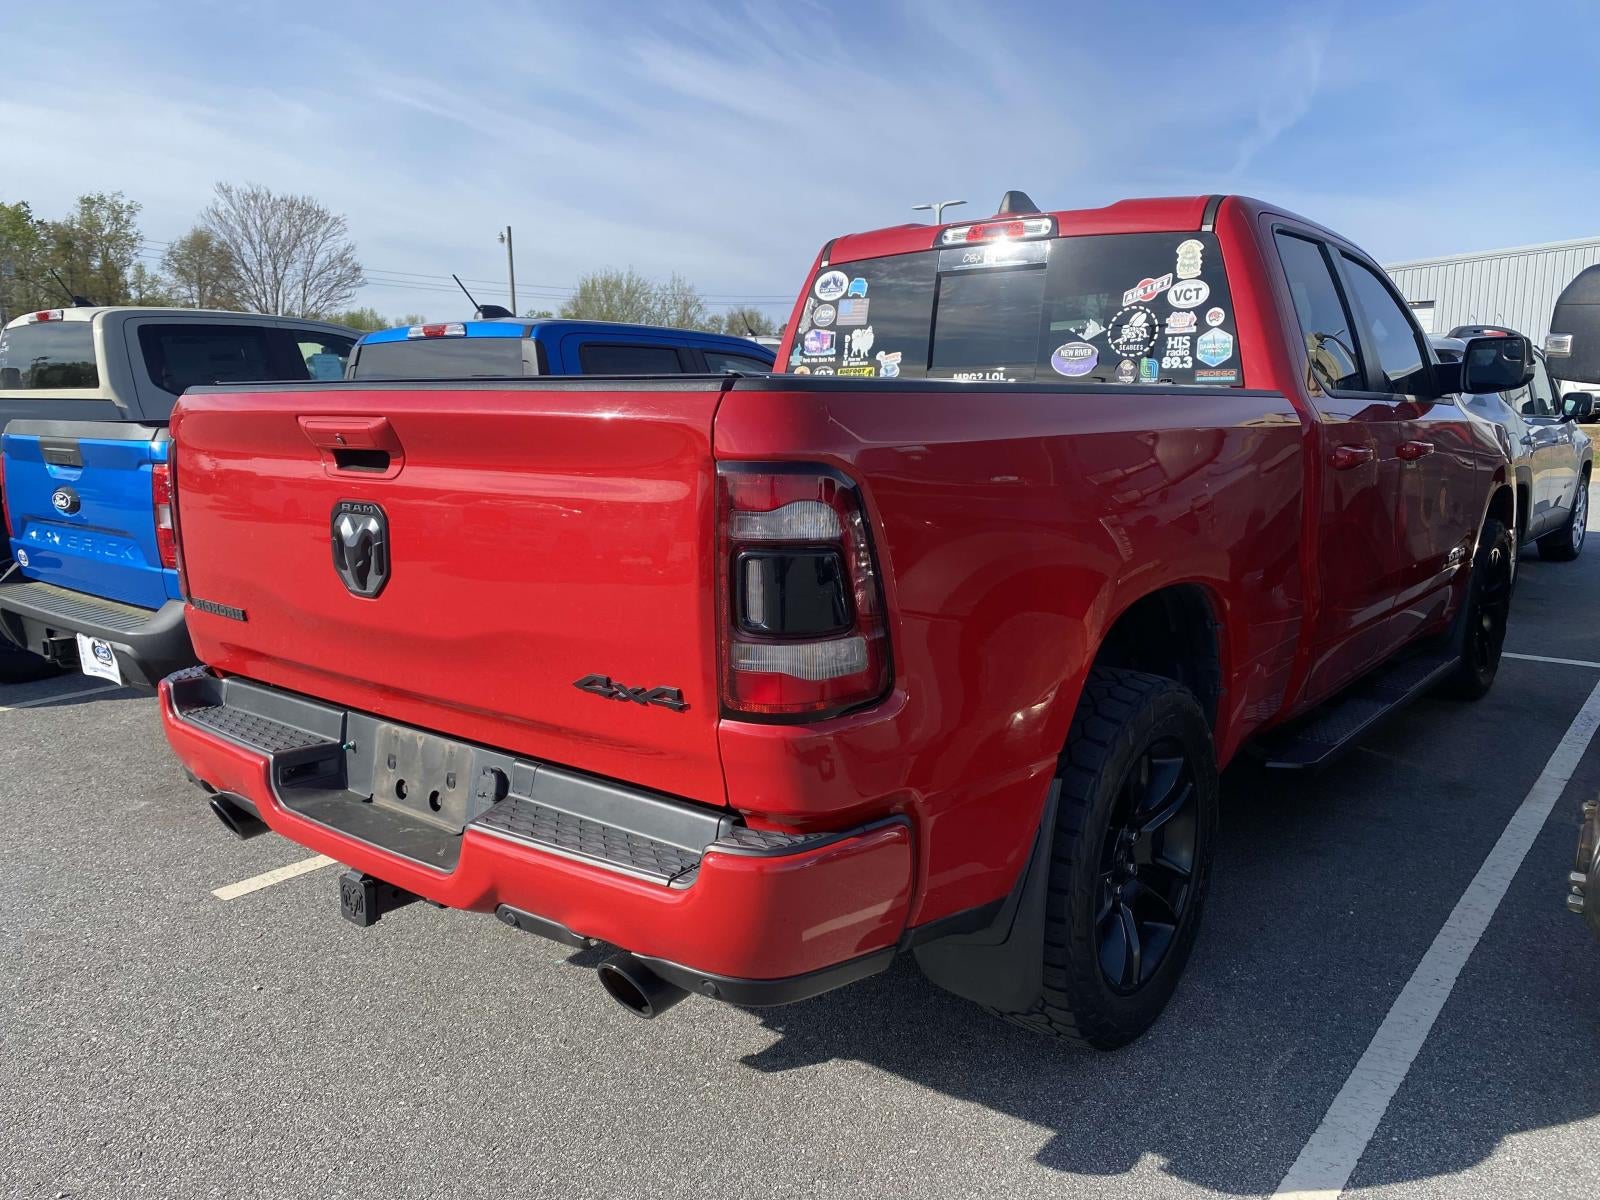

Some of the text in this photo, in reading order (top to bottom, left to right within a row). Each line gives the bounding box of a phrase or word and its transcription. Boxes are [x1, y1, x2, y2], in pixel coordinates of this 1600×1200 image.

[1174, 288, 1202, 302] VCT
[1167, 336, 1191, 349] HIS
[1060, 348, 1092, 357] NEW RIVER
[1166, 348, 1190, 357] radio
[1161, 356, 1193, 369] 89.3
[985, 372, 1006, 381] LOL
[341, 503, 374, 513] RAM
[28, 529, 135, 561] VERCK
